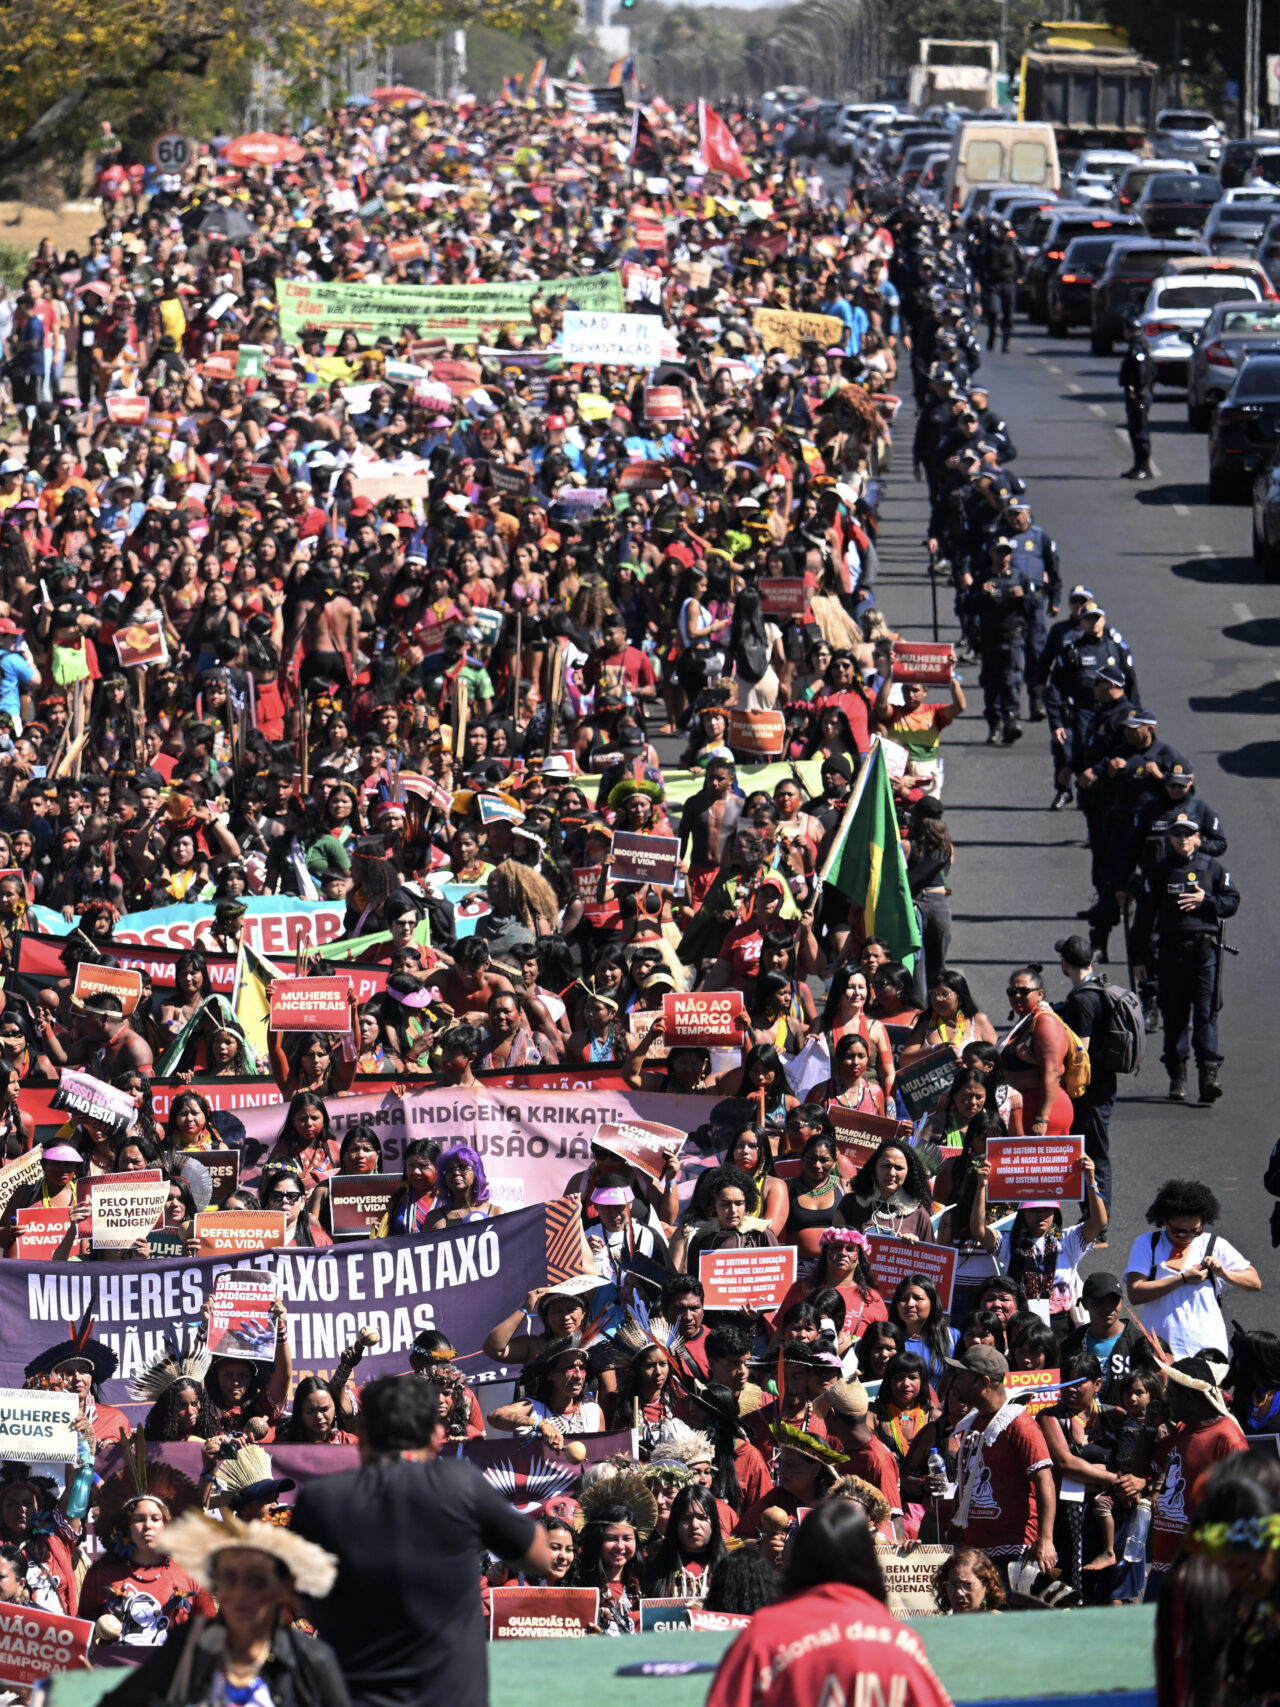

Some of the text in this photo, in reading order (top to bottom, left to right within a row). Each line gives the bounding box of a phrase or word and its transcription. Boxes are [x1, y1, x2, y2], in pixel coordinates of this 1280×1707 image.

[157, 140, 186, 163] 60
[894, 653, 949, 664] MULHERES
[904, 662, 941, 672] TERRAS
[742, 729, 775, 738] DA VIDA
[613, 847, 675, 863] BIODIVERSIDADE
[639, 857, 656, 867] VIDA
[81, 981, 138, 997] DEFENSORAS
[281, 991, 340, 1001] MULHERES
[273, 1001, 345, 1011] ANCESTRAIS
[675, 997, 731, 1013] NÃO AO
[674, 1012, 731, 1025] MARCO
[675, 1025, 732, 1035] TEMPORAL
[901, 1061, 958, 1094] MULHERES
[60, 1078, 93, 1101] NOSSO
[911, 1073, 956, 1102] BIOMAS
[331, 1109, 405, 1132] TERRA
[412, 1101, 521, 1125] INDÍGENA
[1046, 1144, 1074, 1156] EDUCAÇÃO
[1040, 1156, 1069, 1164] EXCLUINDO
[100, 1196, 164, 1207] PELO FUTURO
[98, 1206, 163, 1218] DAS MENINAS
[363, 1203, 387, 1213] VIDA
[200, 1228, 280, 1239] DEFENSORAS
[215, 1239, 265, 1249] DA VIDA
[27, 1224, 501, 1322] MULHERES E PATAXÓ
[217, 1274, 231, 1282] OS
[216, 1281, 273, 1292] DIREITOS
[214, 1300, 235, 1310] SÃO
[1011, 1372, 1053, 1386] POVO
[886, 1564, 910, 1574] BEM
[508, 1615, 581, 1628] GUARDIÃS DA
[696, 1613, 729, 1626] NÃO
[42, 1628, 75, 1646] AO
[845, 1620, 892, 1642] das
